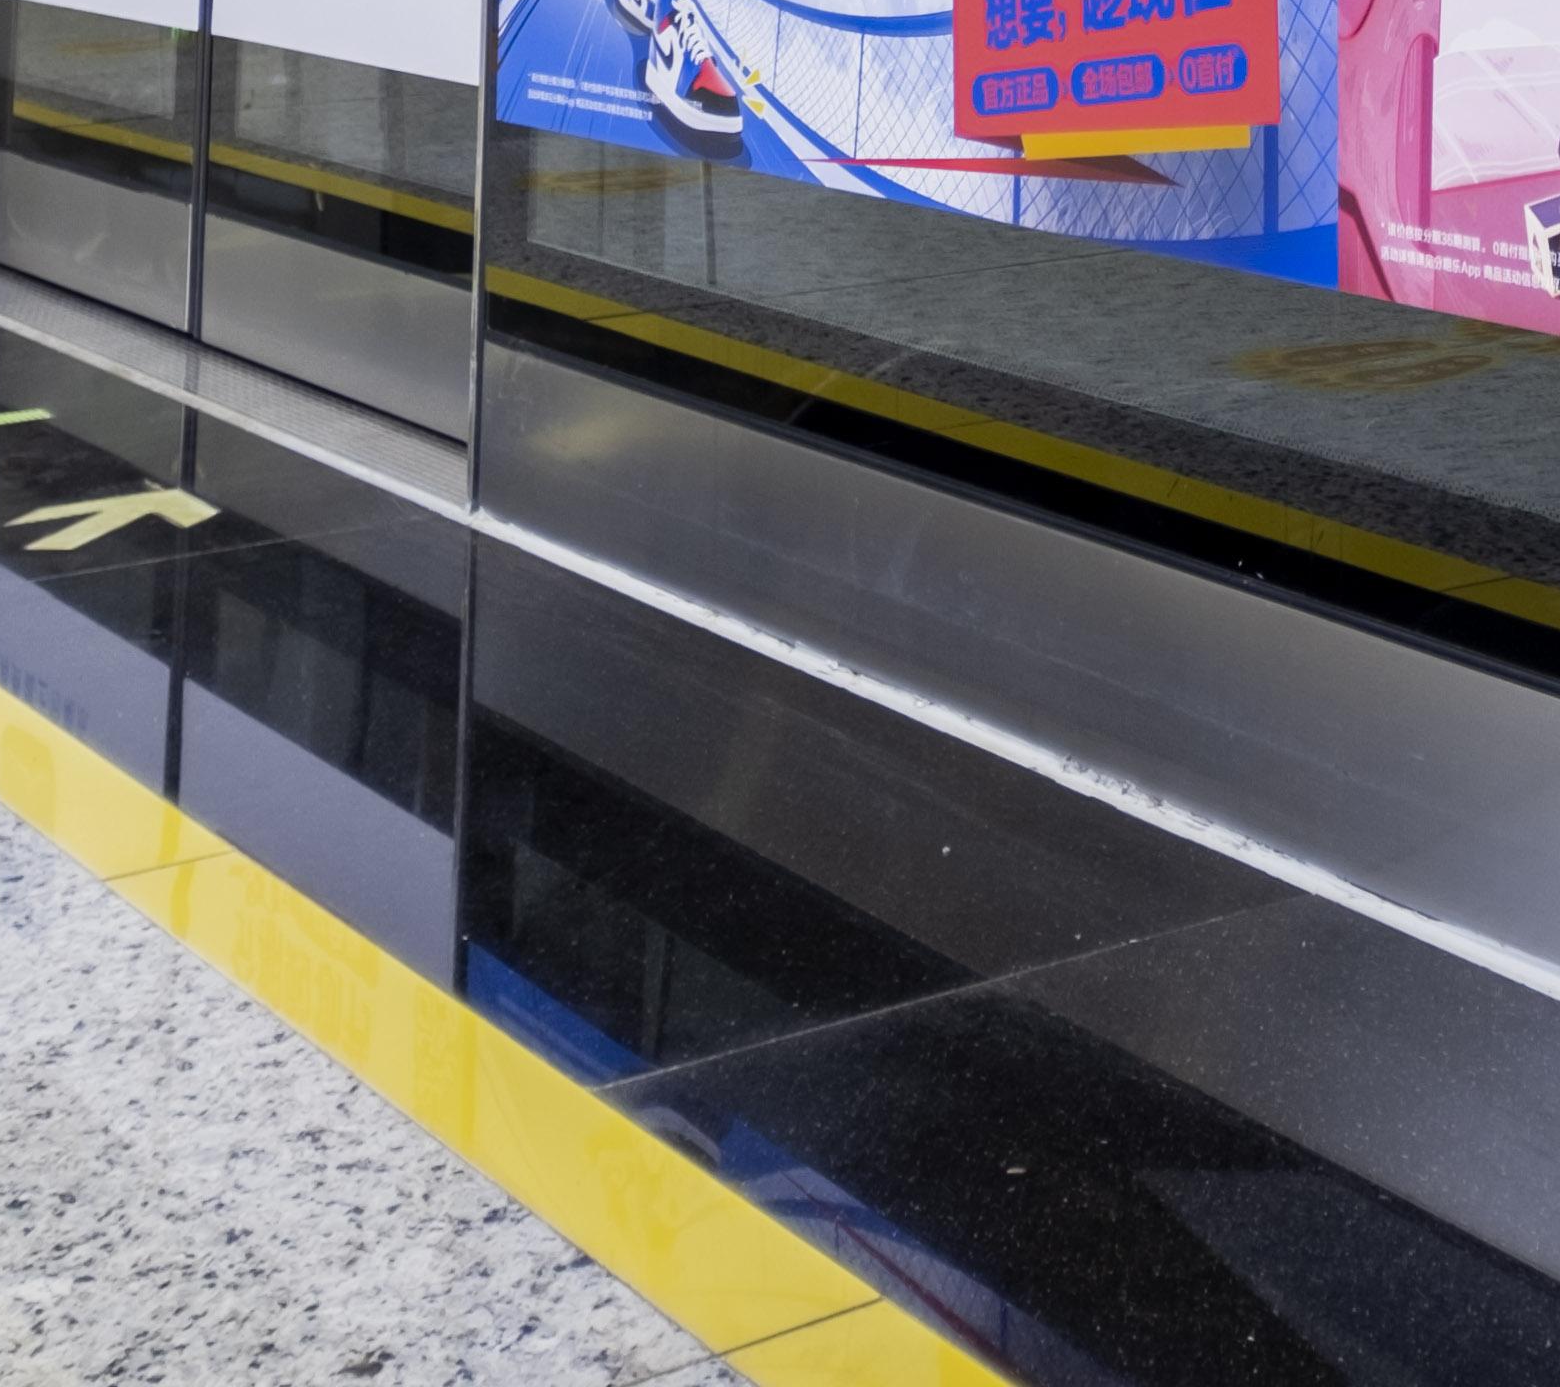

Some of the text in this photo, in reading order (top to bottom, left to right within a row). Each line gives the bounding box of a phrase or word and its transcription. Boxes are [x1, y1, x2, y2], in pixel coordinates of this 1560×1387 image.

[981, 71, 1052, 115] 官方正品
[1078, 61, 1156, 103] 全场包邮
